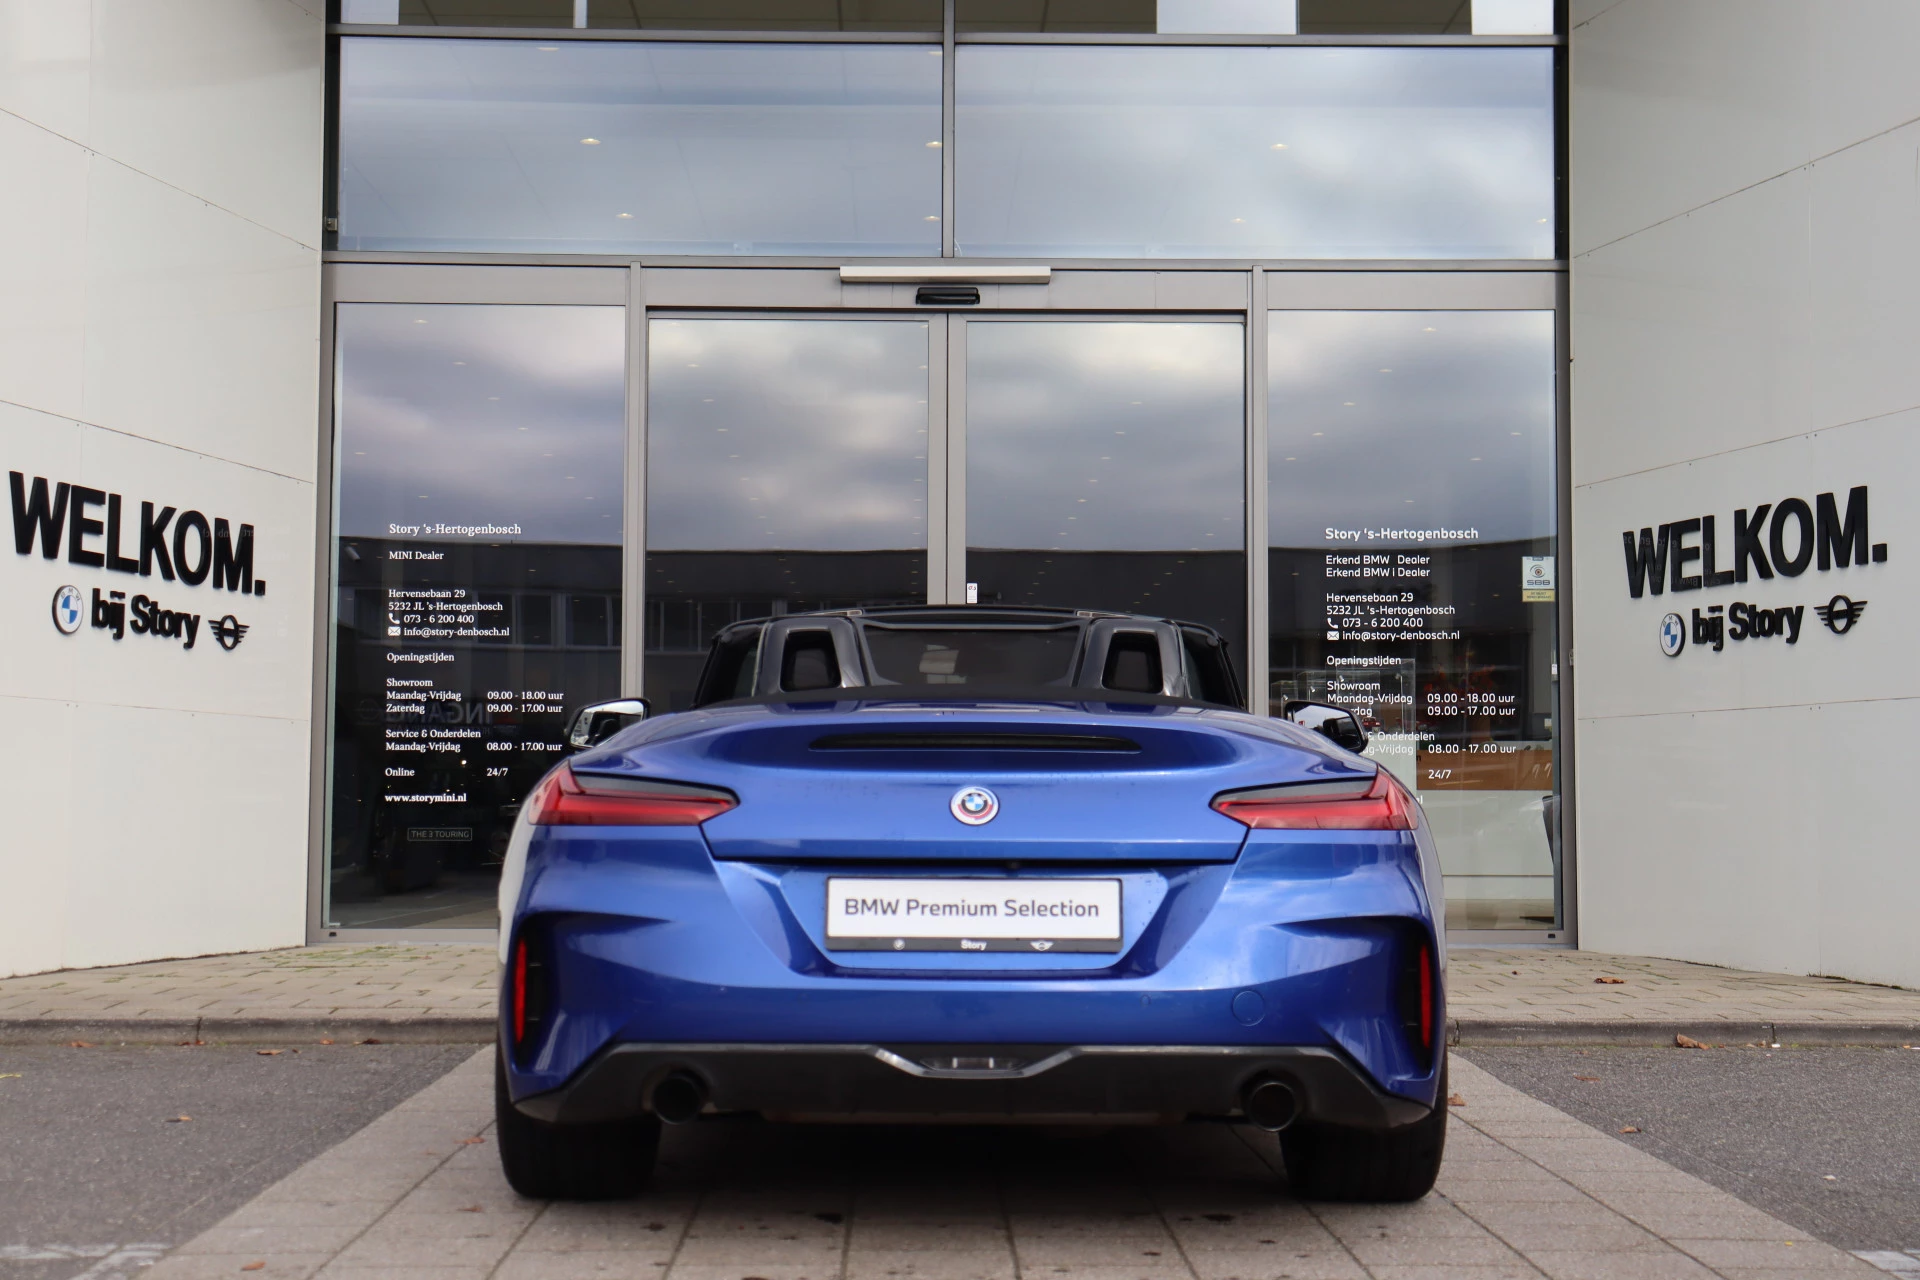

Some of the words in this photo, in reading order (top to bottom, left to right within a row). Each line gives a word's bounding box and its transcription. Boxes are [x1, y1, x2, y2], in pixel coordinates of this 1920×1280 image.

[9, 471, 266, 596] WELKOM.
[389, 523, 420, 537] Story
[1325, 527, 1361, 542] Story
[1623, 485, 1888, 598] WELKOM.
[389, 551, 412, 560] MINI
[415, 551, 444, 560] Dealer
[1326, 555, 1360, 564] Erkend
[1363, 555, 1390, 564] BMW
[1398, 555, 1430, 564] Dealer
[1326, 567, 1360, 577] Erkend
[1363, 567, 1390, 577] BMW
[1398, 567, 1430, 577] Dealer
[388, 589, 452, 598] Hervensebaan
[454, 589, 466, 598] 29
[1326, 592, 1398, 602] Hervensebaan
[1401, 592, 1414, 602] 29
[388, 602, 411, 611] 5232
[413, 602, 425, 611] JL
[1326, 605, 1351, 615] 5232
[1353, 605, 1364, 615] JL
[91, 588, 125, 640] bij
[130, 594, 200, 650] Story
[403, 614, 421, 623] 073
[429, 614, 435, 623] 6
[437, 614, 455, 623] 200
[457, 614, 474, 623] 400
[1342, 618, 1361, 627] 073
[1371, 618, 1378, 627] 6
[1380, 618, 1400, 627] 200
[1403, 617, 1423, 627] 400
[1692, 605, 1724, 652] bij
[1728, 602, 1804, 646] Story
[404, 626, 510, 639] info@story-denbosch.nl
[1342, 630, 1460, 642] info@story-denbosch.nl
[386, 652, 455, 664] Openingstijden
[1326, 655, 1402, 667] Openingstijden
[386, 678, 433, 687] Showroom
[1327, 681, 1381, 690] Showroom
[386, 690, 461, 702] Maandag-Vrijdag
[487, 691, 513, 700] 09.00
[521, 691, 546, 700] 18.00
[1327, 693, 1413, 705] Maandag-Vrijdag
[1427, 693, 1457, 703] 09.00
[1467, 693, 1496, 703] 18.00
[1498, 695, 1515, 703] uur
[386, 703, 425, 714] Zaterdag
[487, 704, 513, 712] 09.00
[521, 704, 545, 712] 17.00
[1427, 706, 1457, 715] 09.00
[386, 729, 419, 738] Service
[421, 729, 428, 738] &
[430, 729, 481, 738] Onderdelen
[1378, 732, 1435, 741] Onderdelen
[386, 742, 461, 753] Maandag-Vrijdag
[486, 742, 512, 751] 08.00
[521, 742, 545, 751] 17.00
[1428, 744, 1459, 753] 08.00
[385, 767, 415, 776] Online
[486, 768, 508, 777] 24/7
[1428, 769, 1452, 779] 24/7
[385, 793, 467, 804] www.storymini.nl
[844, 899, 900, 916] BMW
[906, 899, 997, 917] Premium
[1004, 899, 1099, 918] Selection
[961, 939, 987, 950] Story
